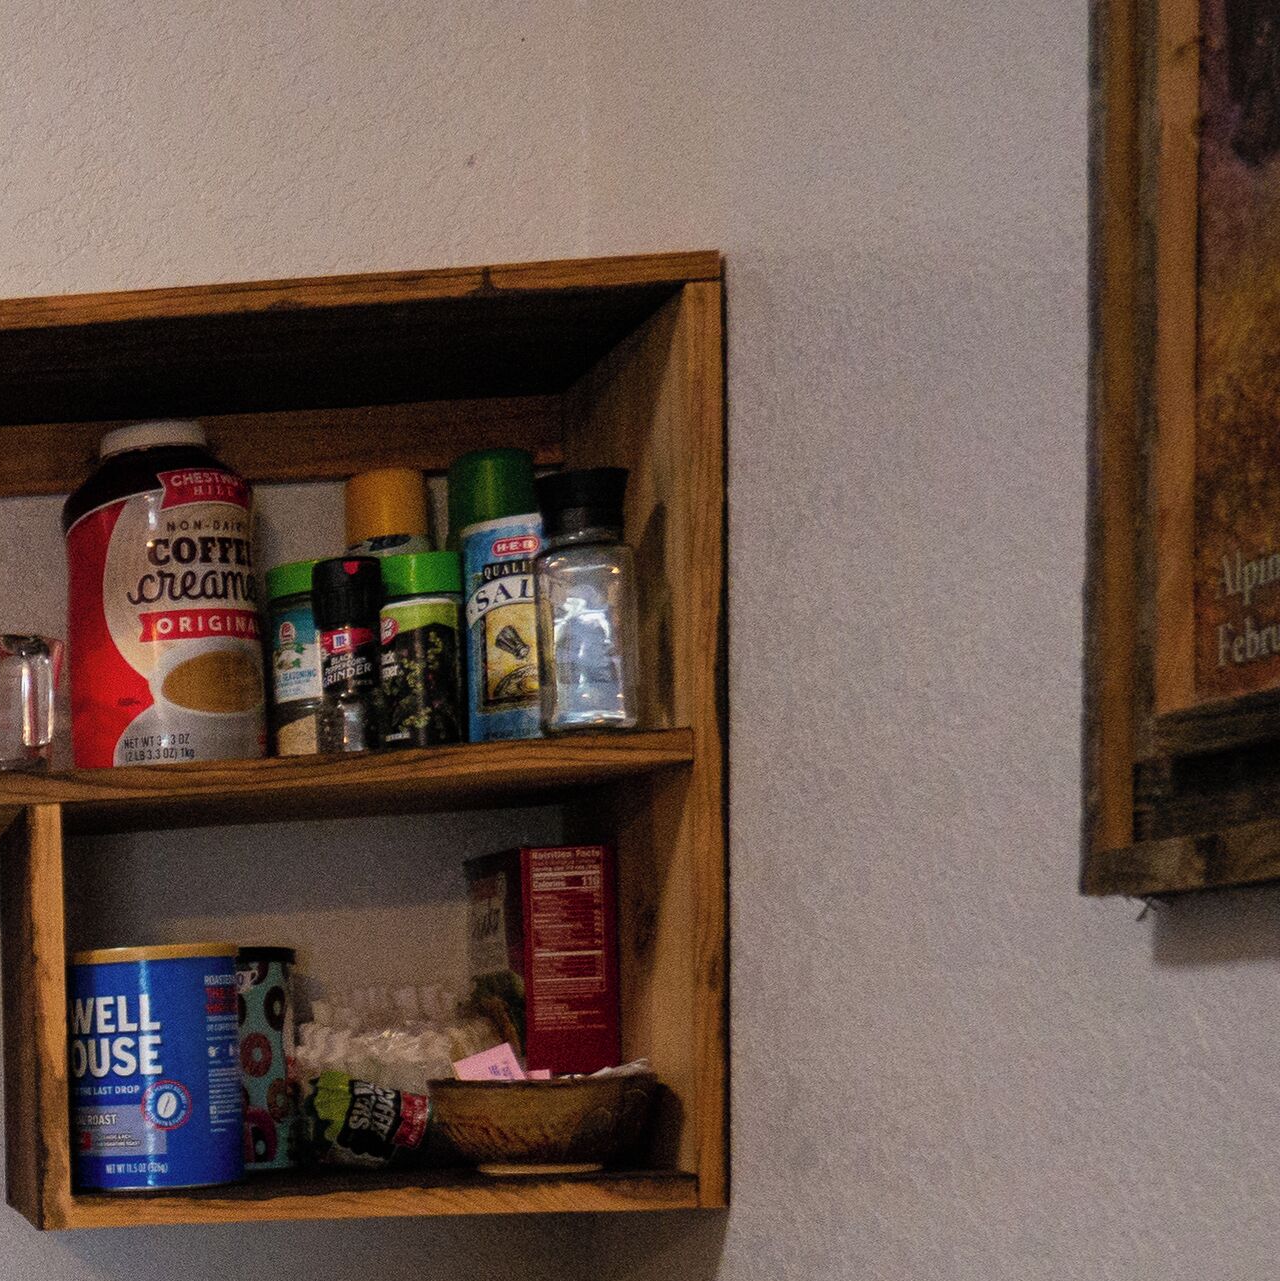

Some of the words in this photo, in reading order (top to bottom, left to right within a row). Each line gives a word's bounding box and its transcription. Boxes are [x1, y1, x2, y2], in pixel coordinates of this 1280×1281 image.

[193, 485, 234, 497] HILL
[475, 578, 535, 613] SAL
[124, 737, 139, 749] NET
[141, 735, 154, 747] WT
[178, 733, 190, 745] OZ
[134, 750, 145, 761] LB
[147, 749, 161, 760] 3.3
[181, 747, 195, 760] 1kg
[93, 1085, 113, 1096] LAST
[115, 1084, 141, 1095] DROP
